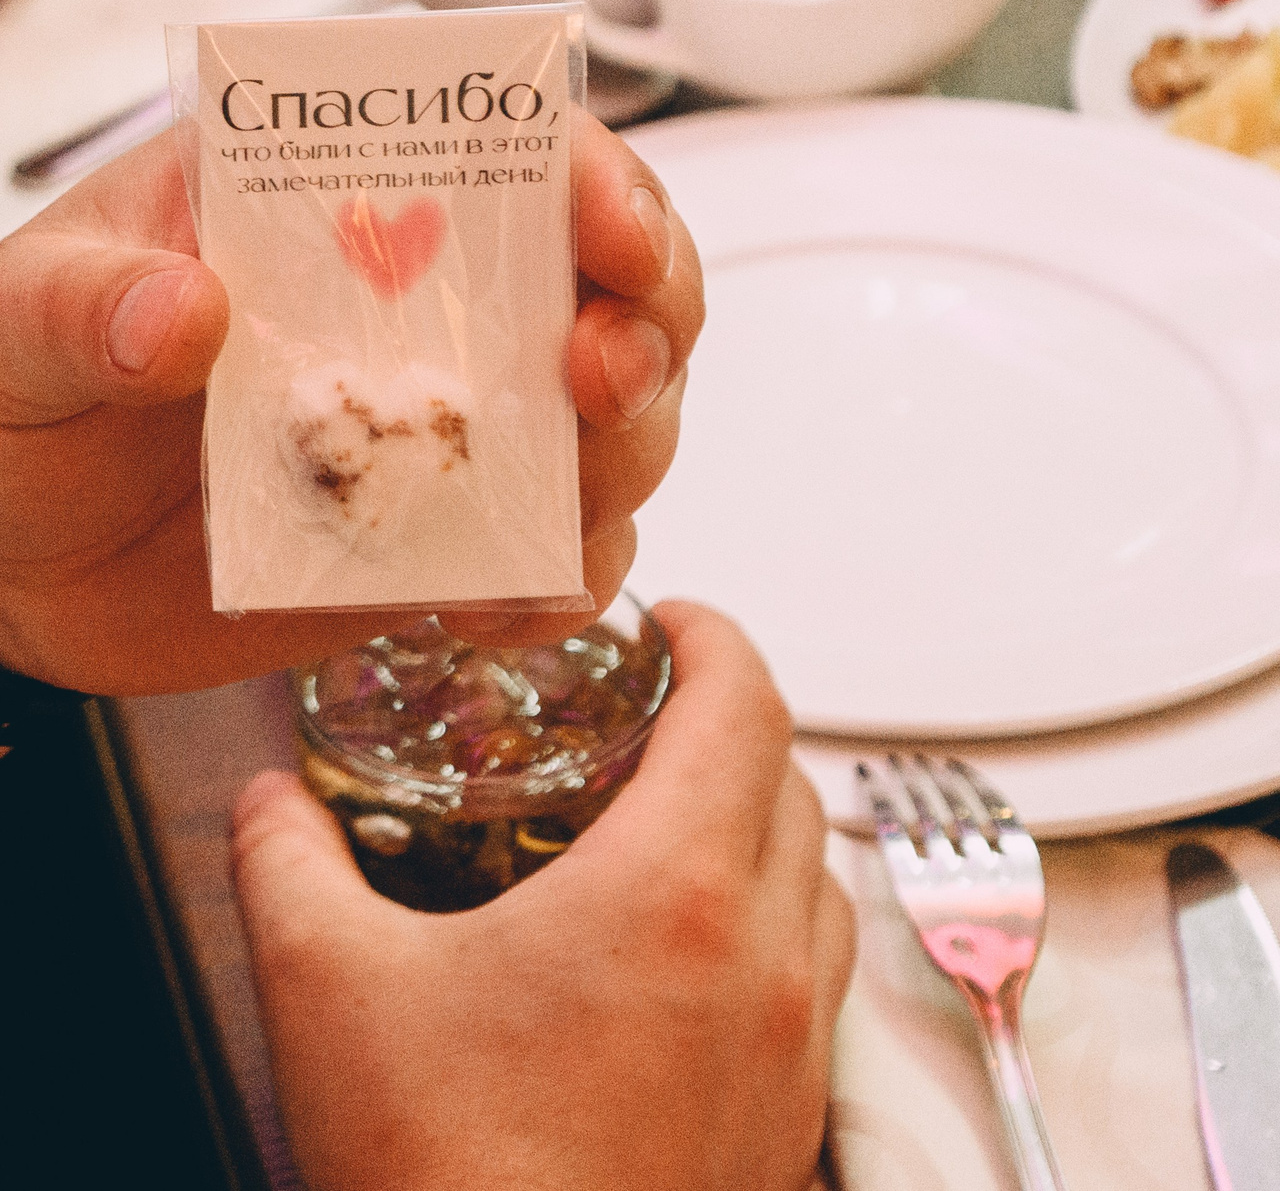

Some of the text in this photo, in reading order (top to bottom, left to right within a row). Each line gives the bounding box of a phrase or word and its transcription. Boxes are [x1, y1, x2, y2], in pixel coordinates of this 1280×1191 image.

[222, 72, 559, 132] Спасибо,
[221, 134, 559, 162] что были с нами в этот
[237, 161, 550, 194] замечательный день!
